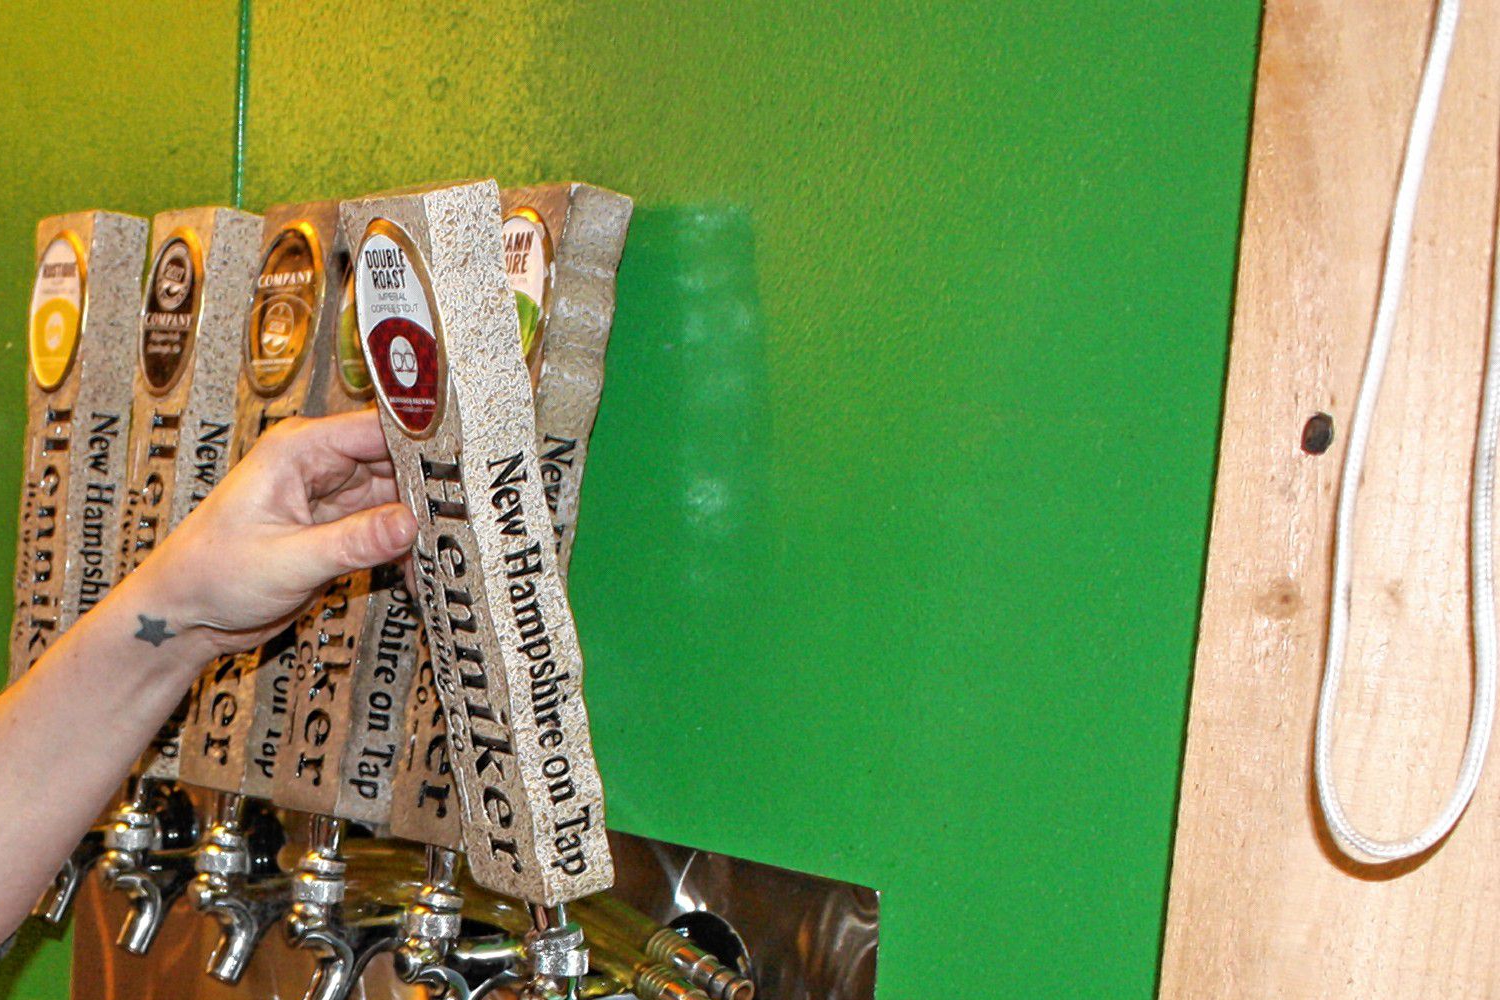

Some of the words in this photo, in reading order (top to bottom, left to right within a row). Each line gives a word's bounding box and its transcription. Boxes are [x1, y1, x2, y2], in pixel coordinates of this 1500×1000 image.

[364, 247, 407, 269] DOUBLE
[502, 231, 535, 253] AMN
[257, 269, 314, 289] COMPANY
[371, 269, 407, 290] ROAST
[87, 411, 120, 477] New
[192, 419, 231, 486] New
[486, 449, 528, 538] New
[28, 404, 73, 669] Hennik
[418, 451, 522, 876] Henniker
[504, 540, 570, 748] Hampshire
[367, 691, 393, 732] on
[349, 743, 397, 800] Tap
[540, 756, 577, 809] on
[548, 804, 595, 877] Tap
